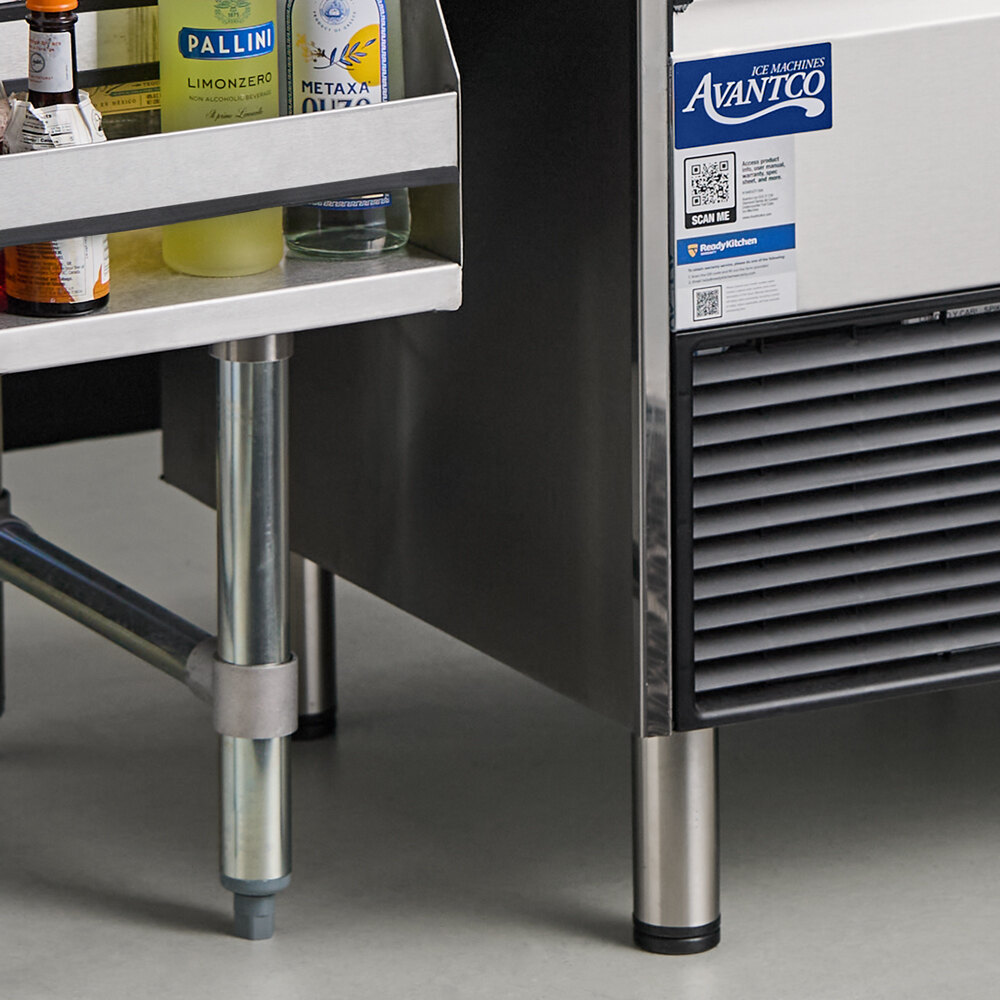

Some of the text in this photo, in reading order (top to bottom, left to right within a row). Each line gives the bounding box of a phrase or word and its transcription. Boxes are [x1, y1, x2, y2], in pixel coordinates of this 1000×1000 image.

[188, 28, 272, 54] PALLINI
[751, 56, 826, 77] ICE MACHINES
[187, 72, 272, 90] LIMONZERO
[301, 80, 370, 96] METAXA
[682, 69, 826, 125] AVANTCO
[691, 213, 715, 226] SCAN
[716, 210, 730, 222] ME
[700, 237, 758, 252] ReadyKitchen
